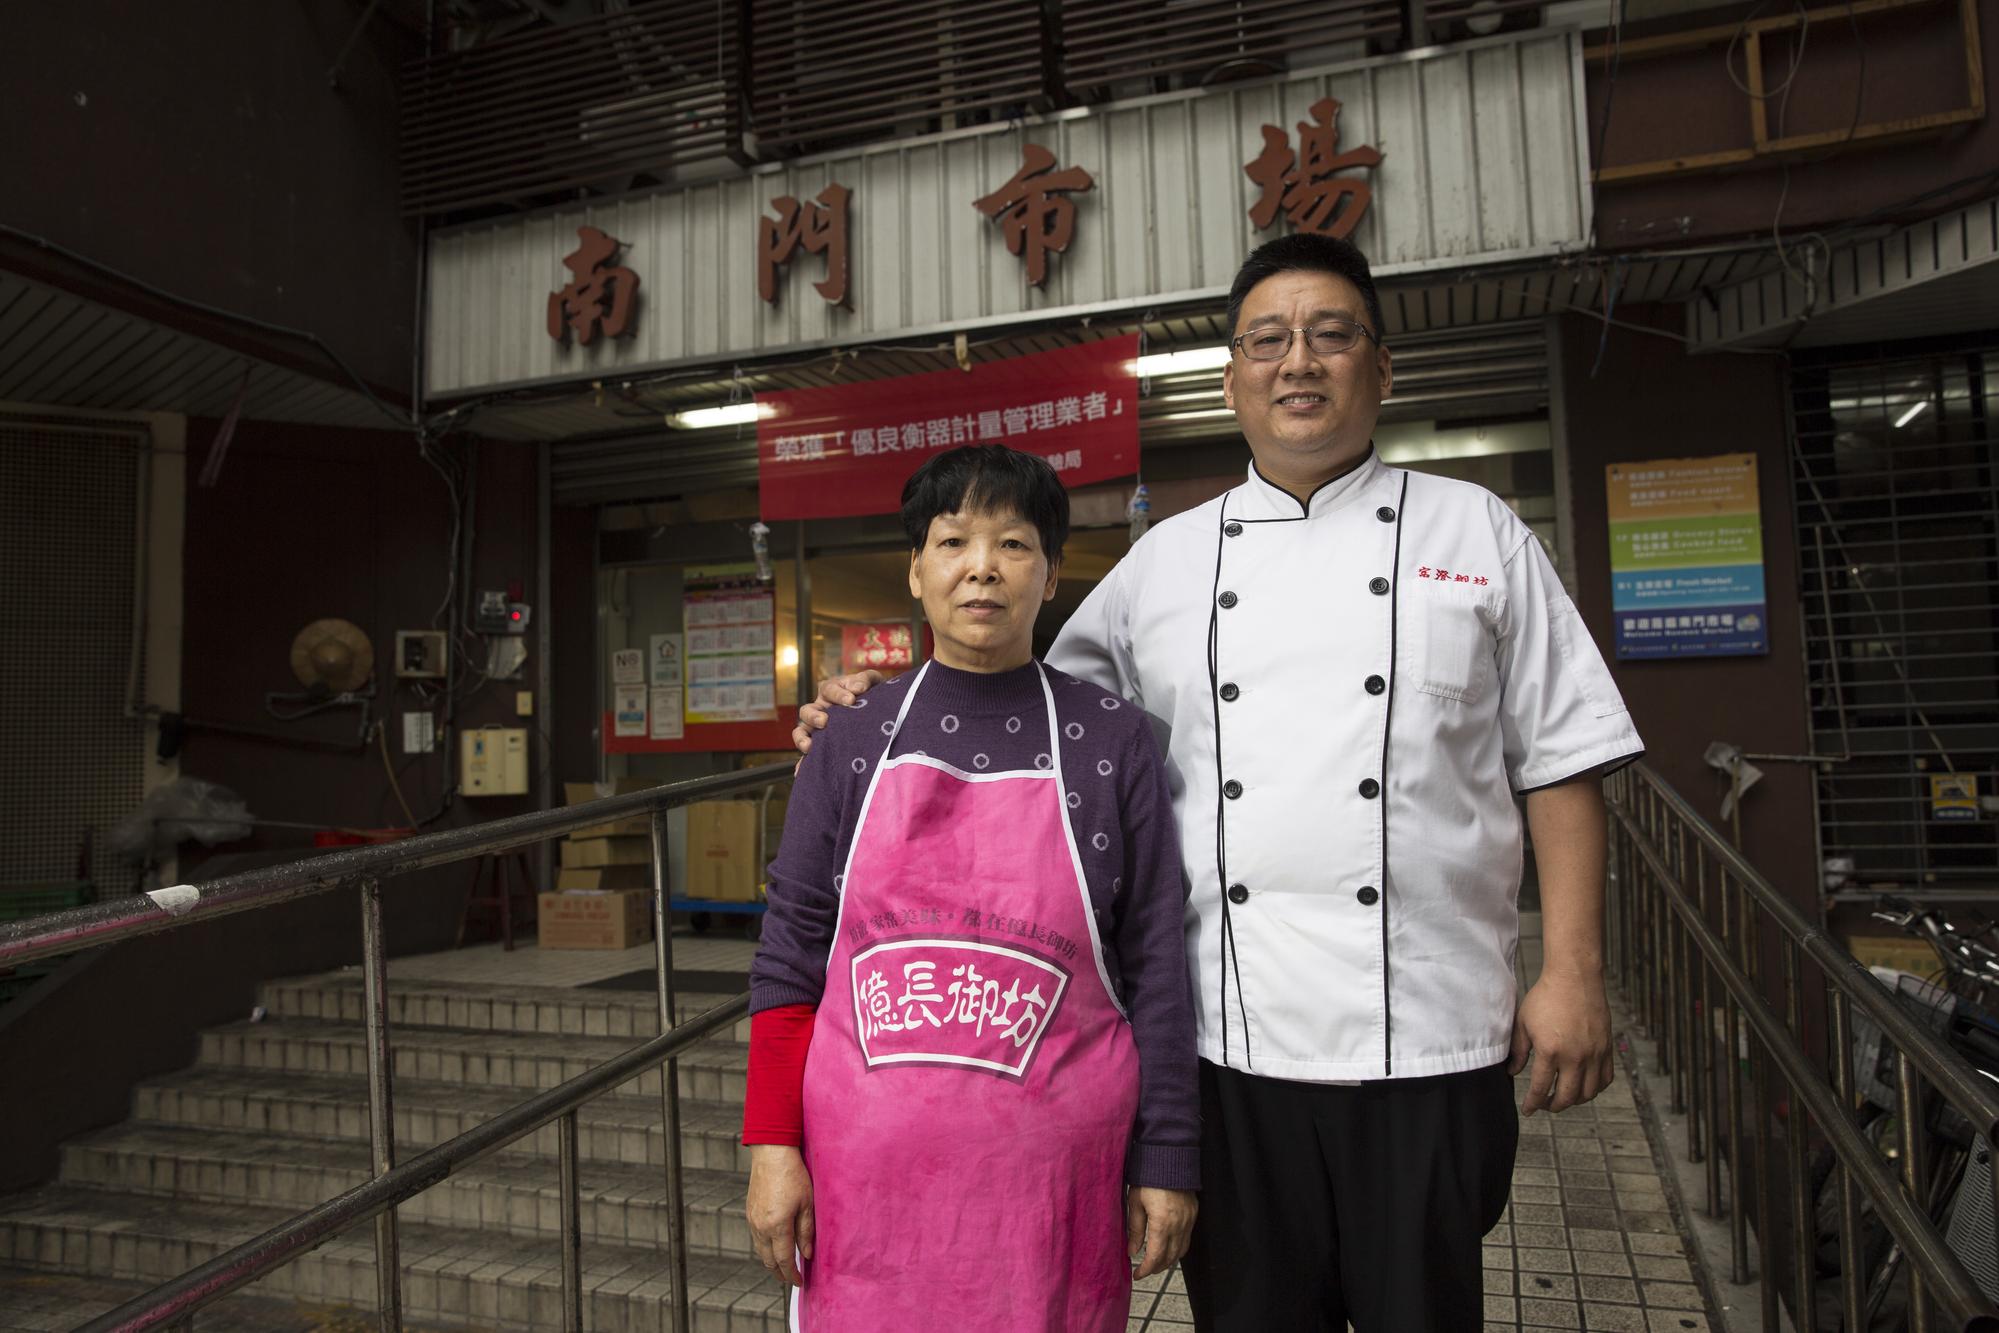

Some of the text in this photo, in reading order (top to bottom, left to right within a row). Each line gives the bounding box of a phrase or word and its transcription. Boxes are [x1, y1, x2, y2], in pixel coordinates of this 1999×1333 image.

[547, 97, 1382, 345] 南門市場
[774, 391, 1124, 462] 榮獲「優良衡器計量管理業者」
[860, 960, 1047, 1048] 億長御坊
